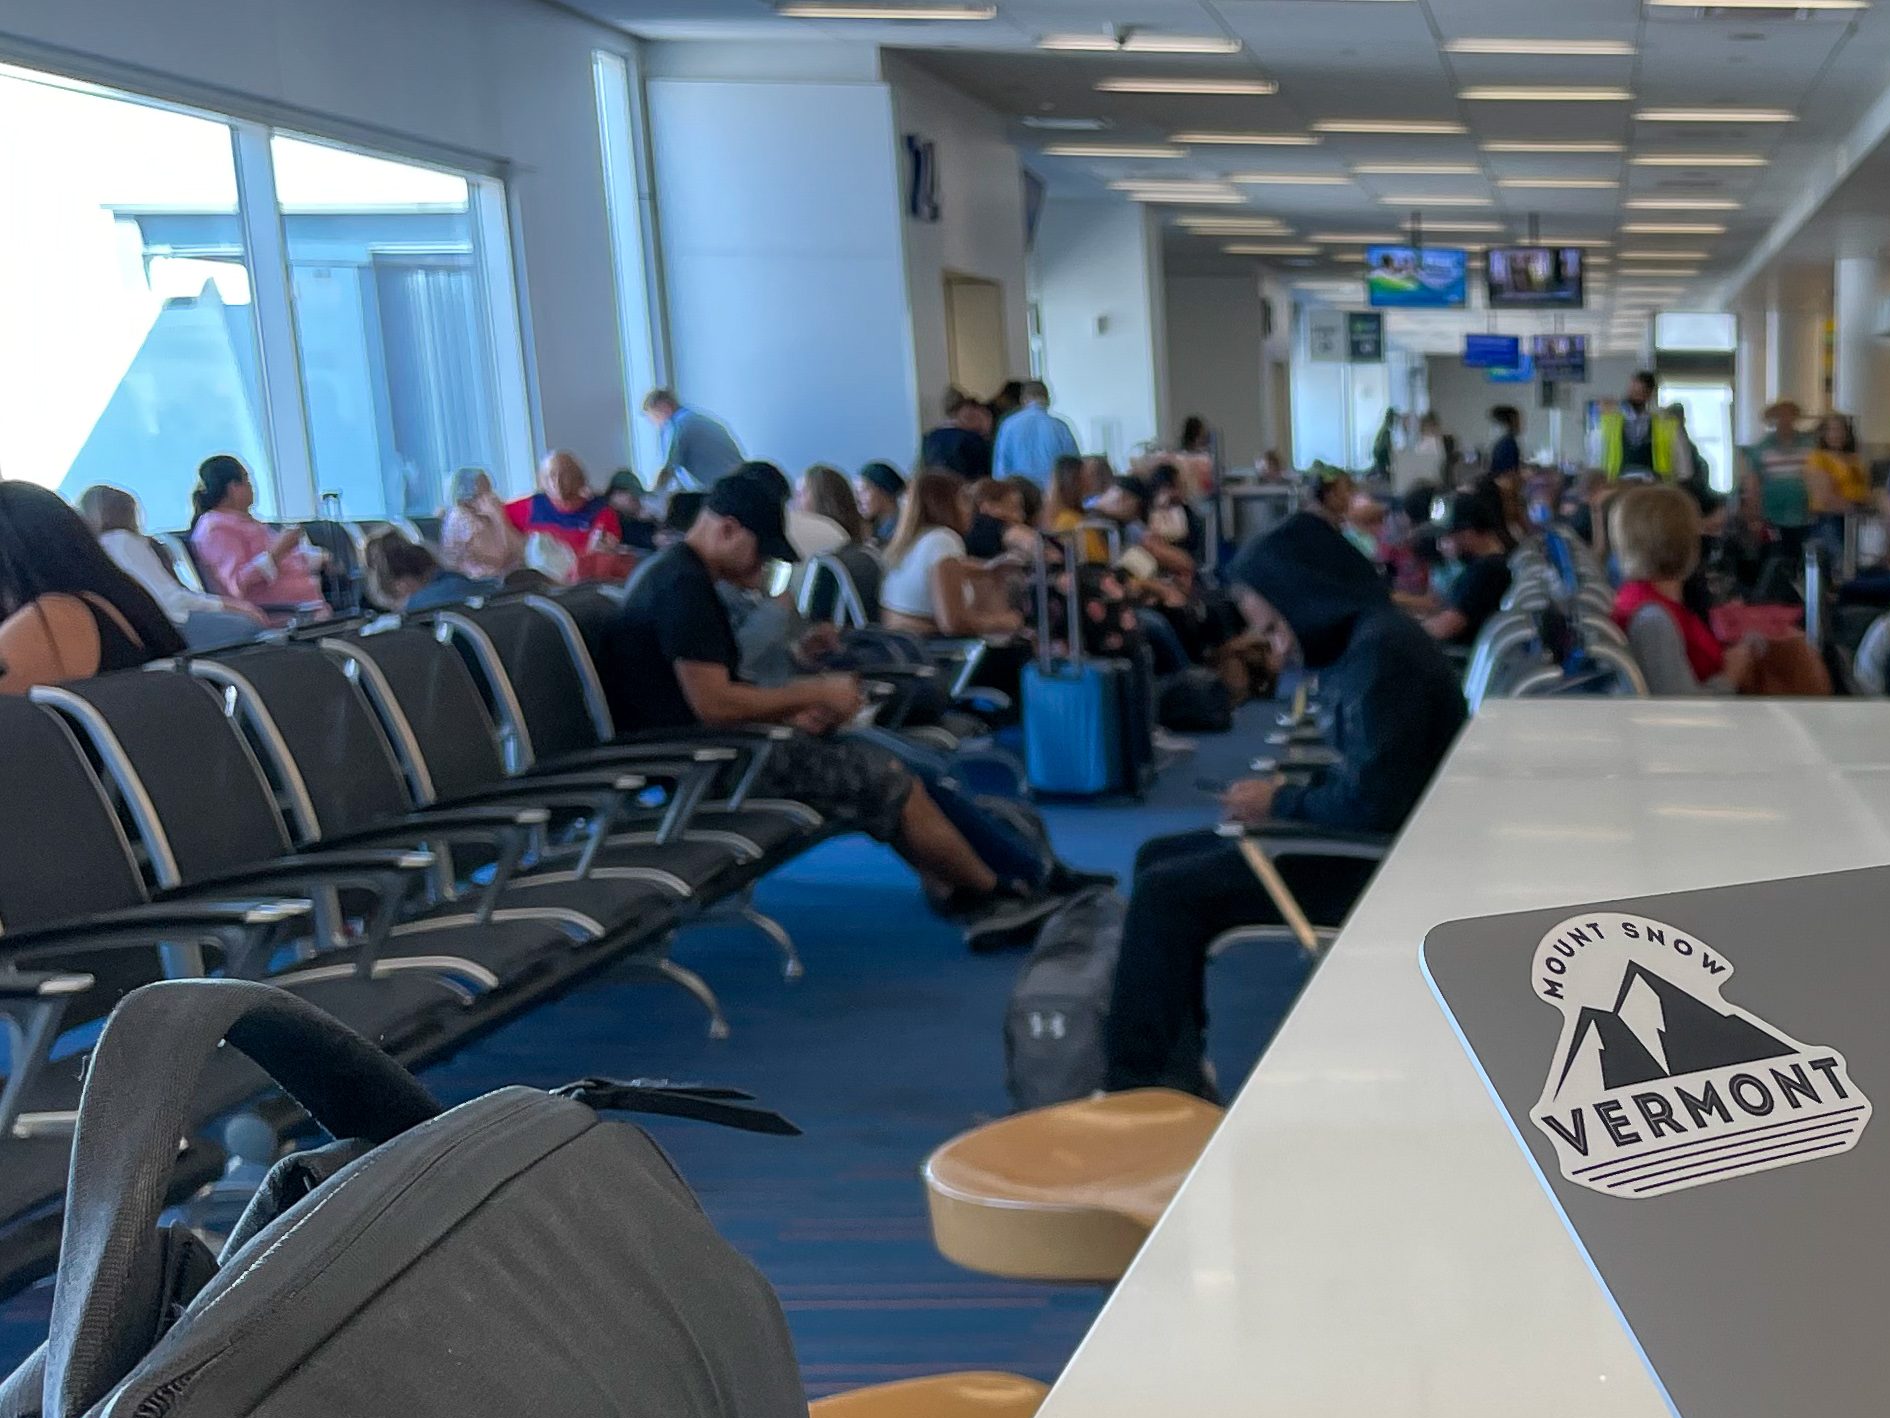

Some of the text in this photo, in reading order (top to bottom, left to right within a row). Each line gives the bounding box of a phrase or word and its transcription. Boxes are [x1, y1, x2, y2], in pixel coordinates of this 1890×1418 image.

[1543, 921, 1726, 1000] MOUNT SNOW
[1541, 1056, 1849, 1158] VERMONT
